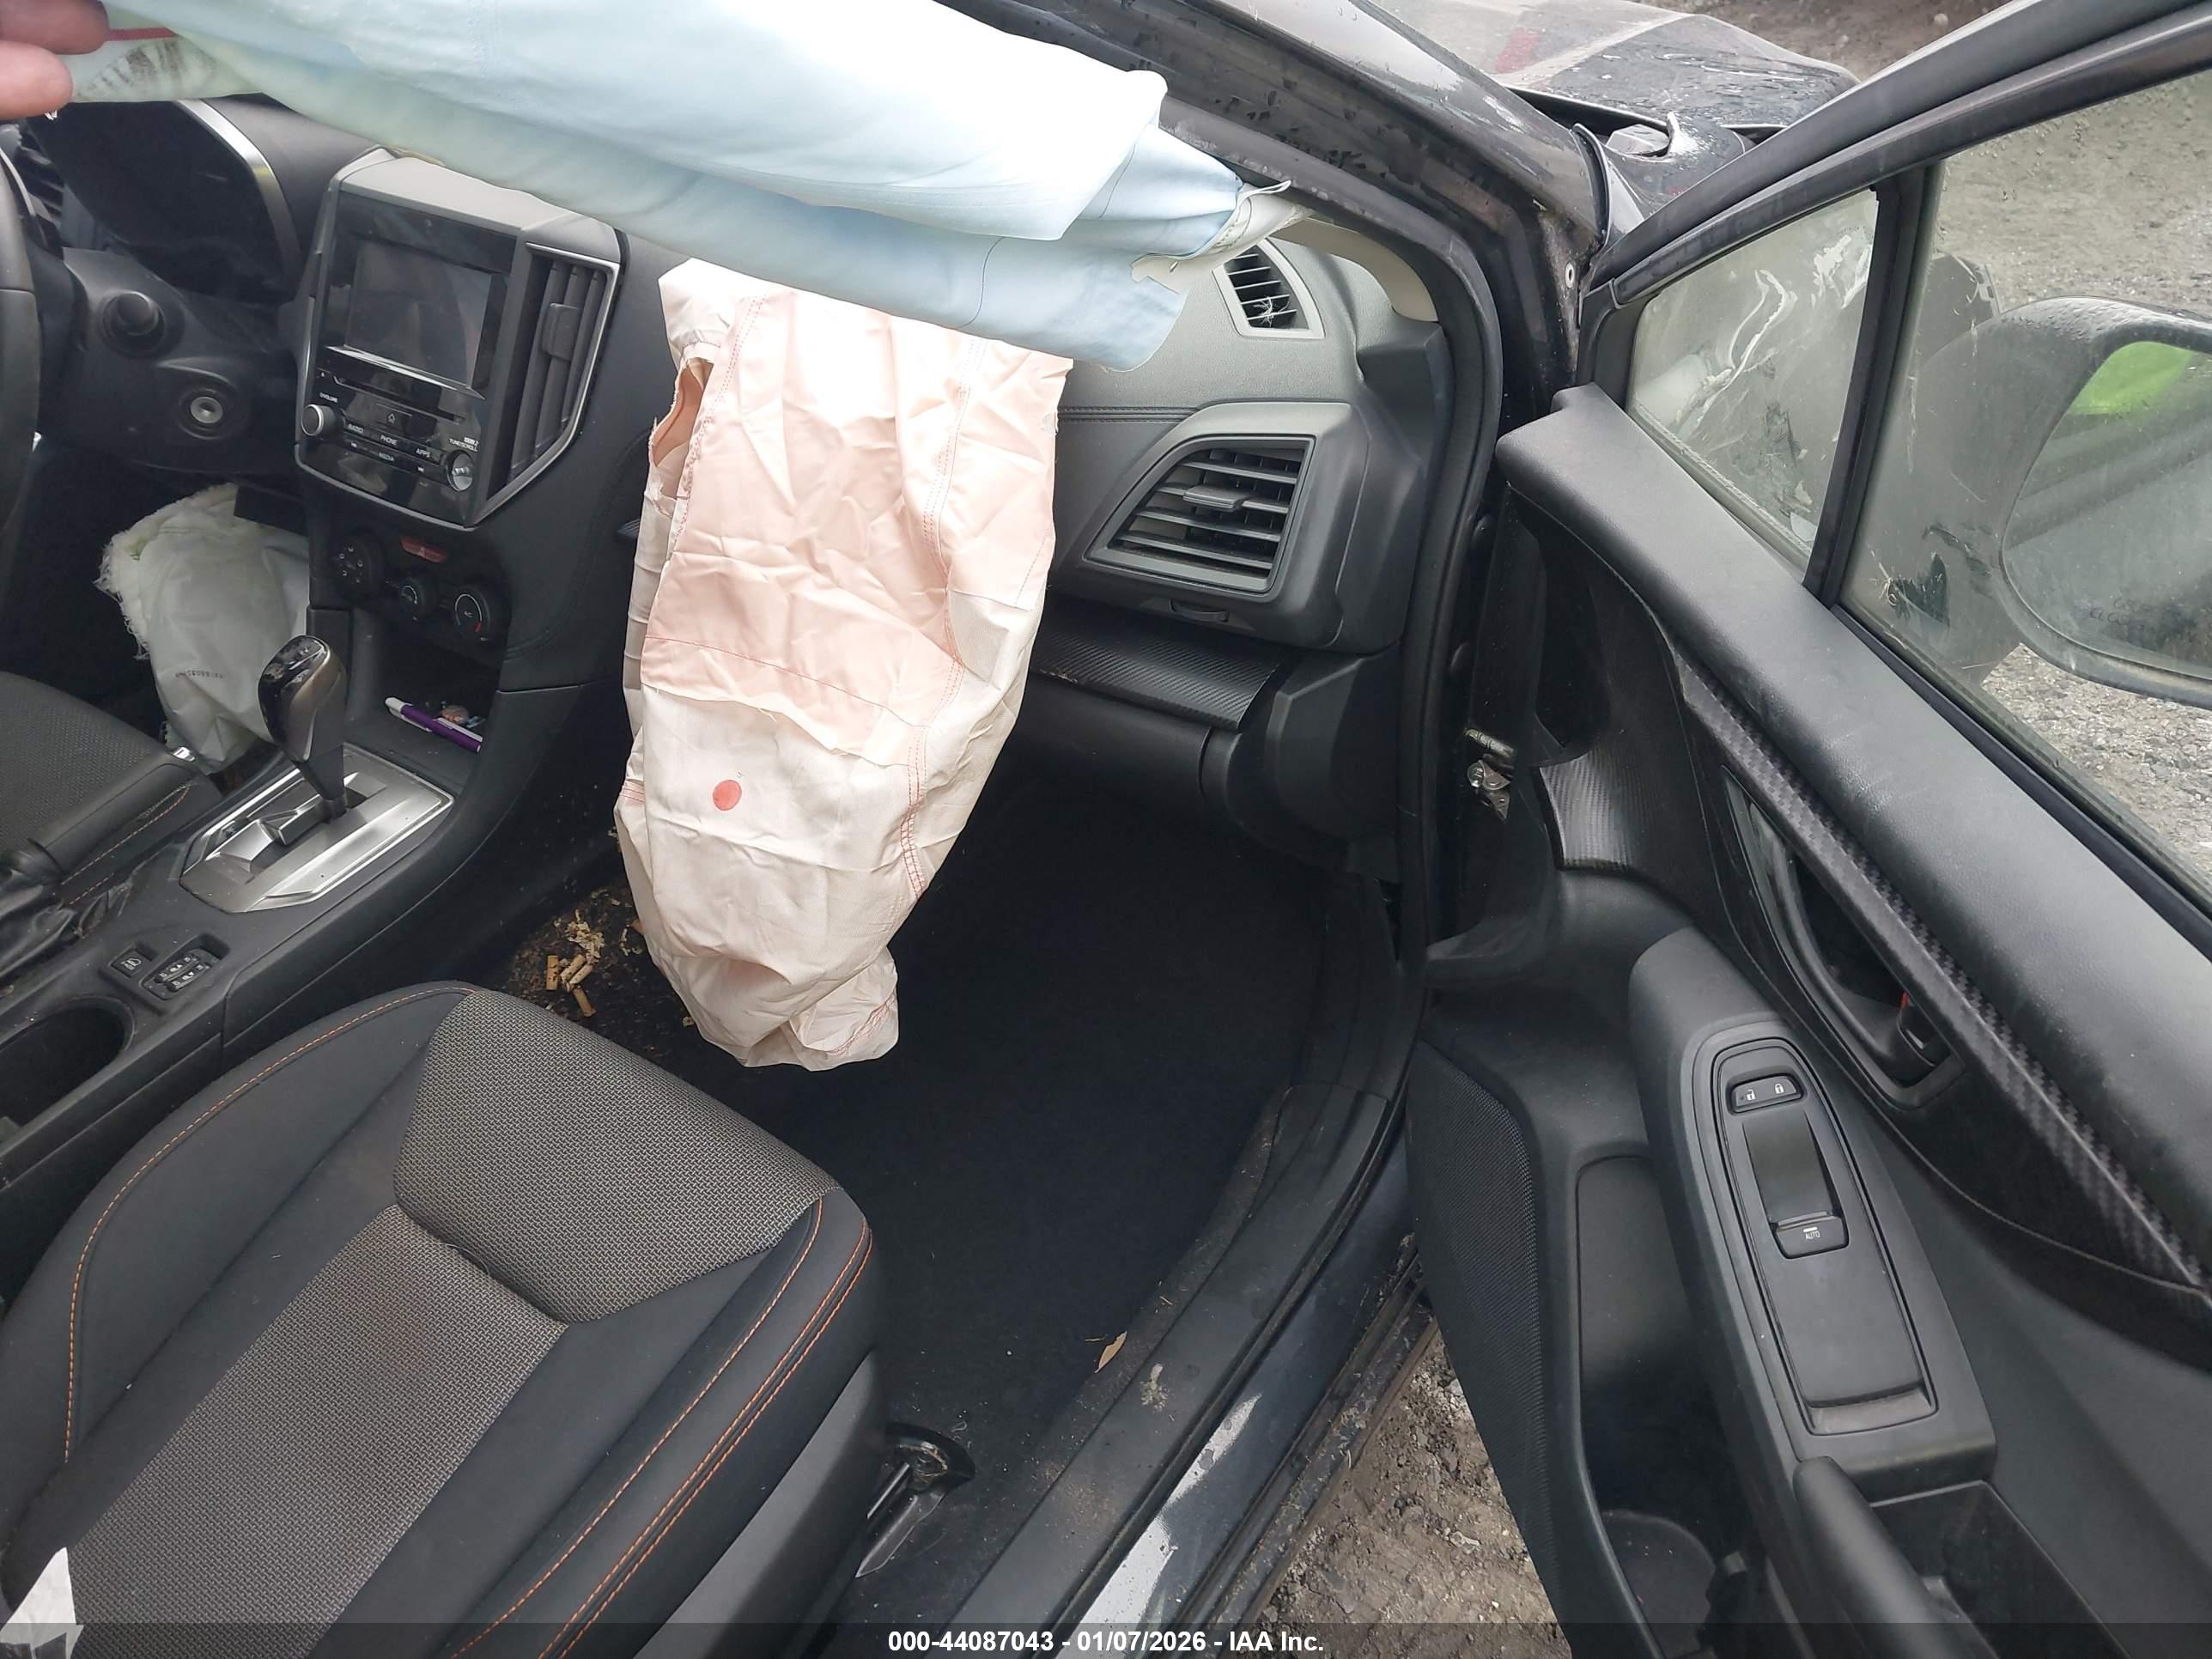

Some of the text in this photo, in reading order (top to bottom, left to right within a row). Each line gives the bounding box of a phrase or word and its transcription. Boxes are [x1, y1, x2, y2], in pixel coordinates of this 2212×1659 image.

[380, 434, 398, 445] PHONE
[416, 448, 430, 459] APPS
[1805, 1231, 1820, 1240] AUTO
